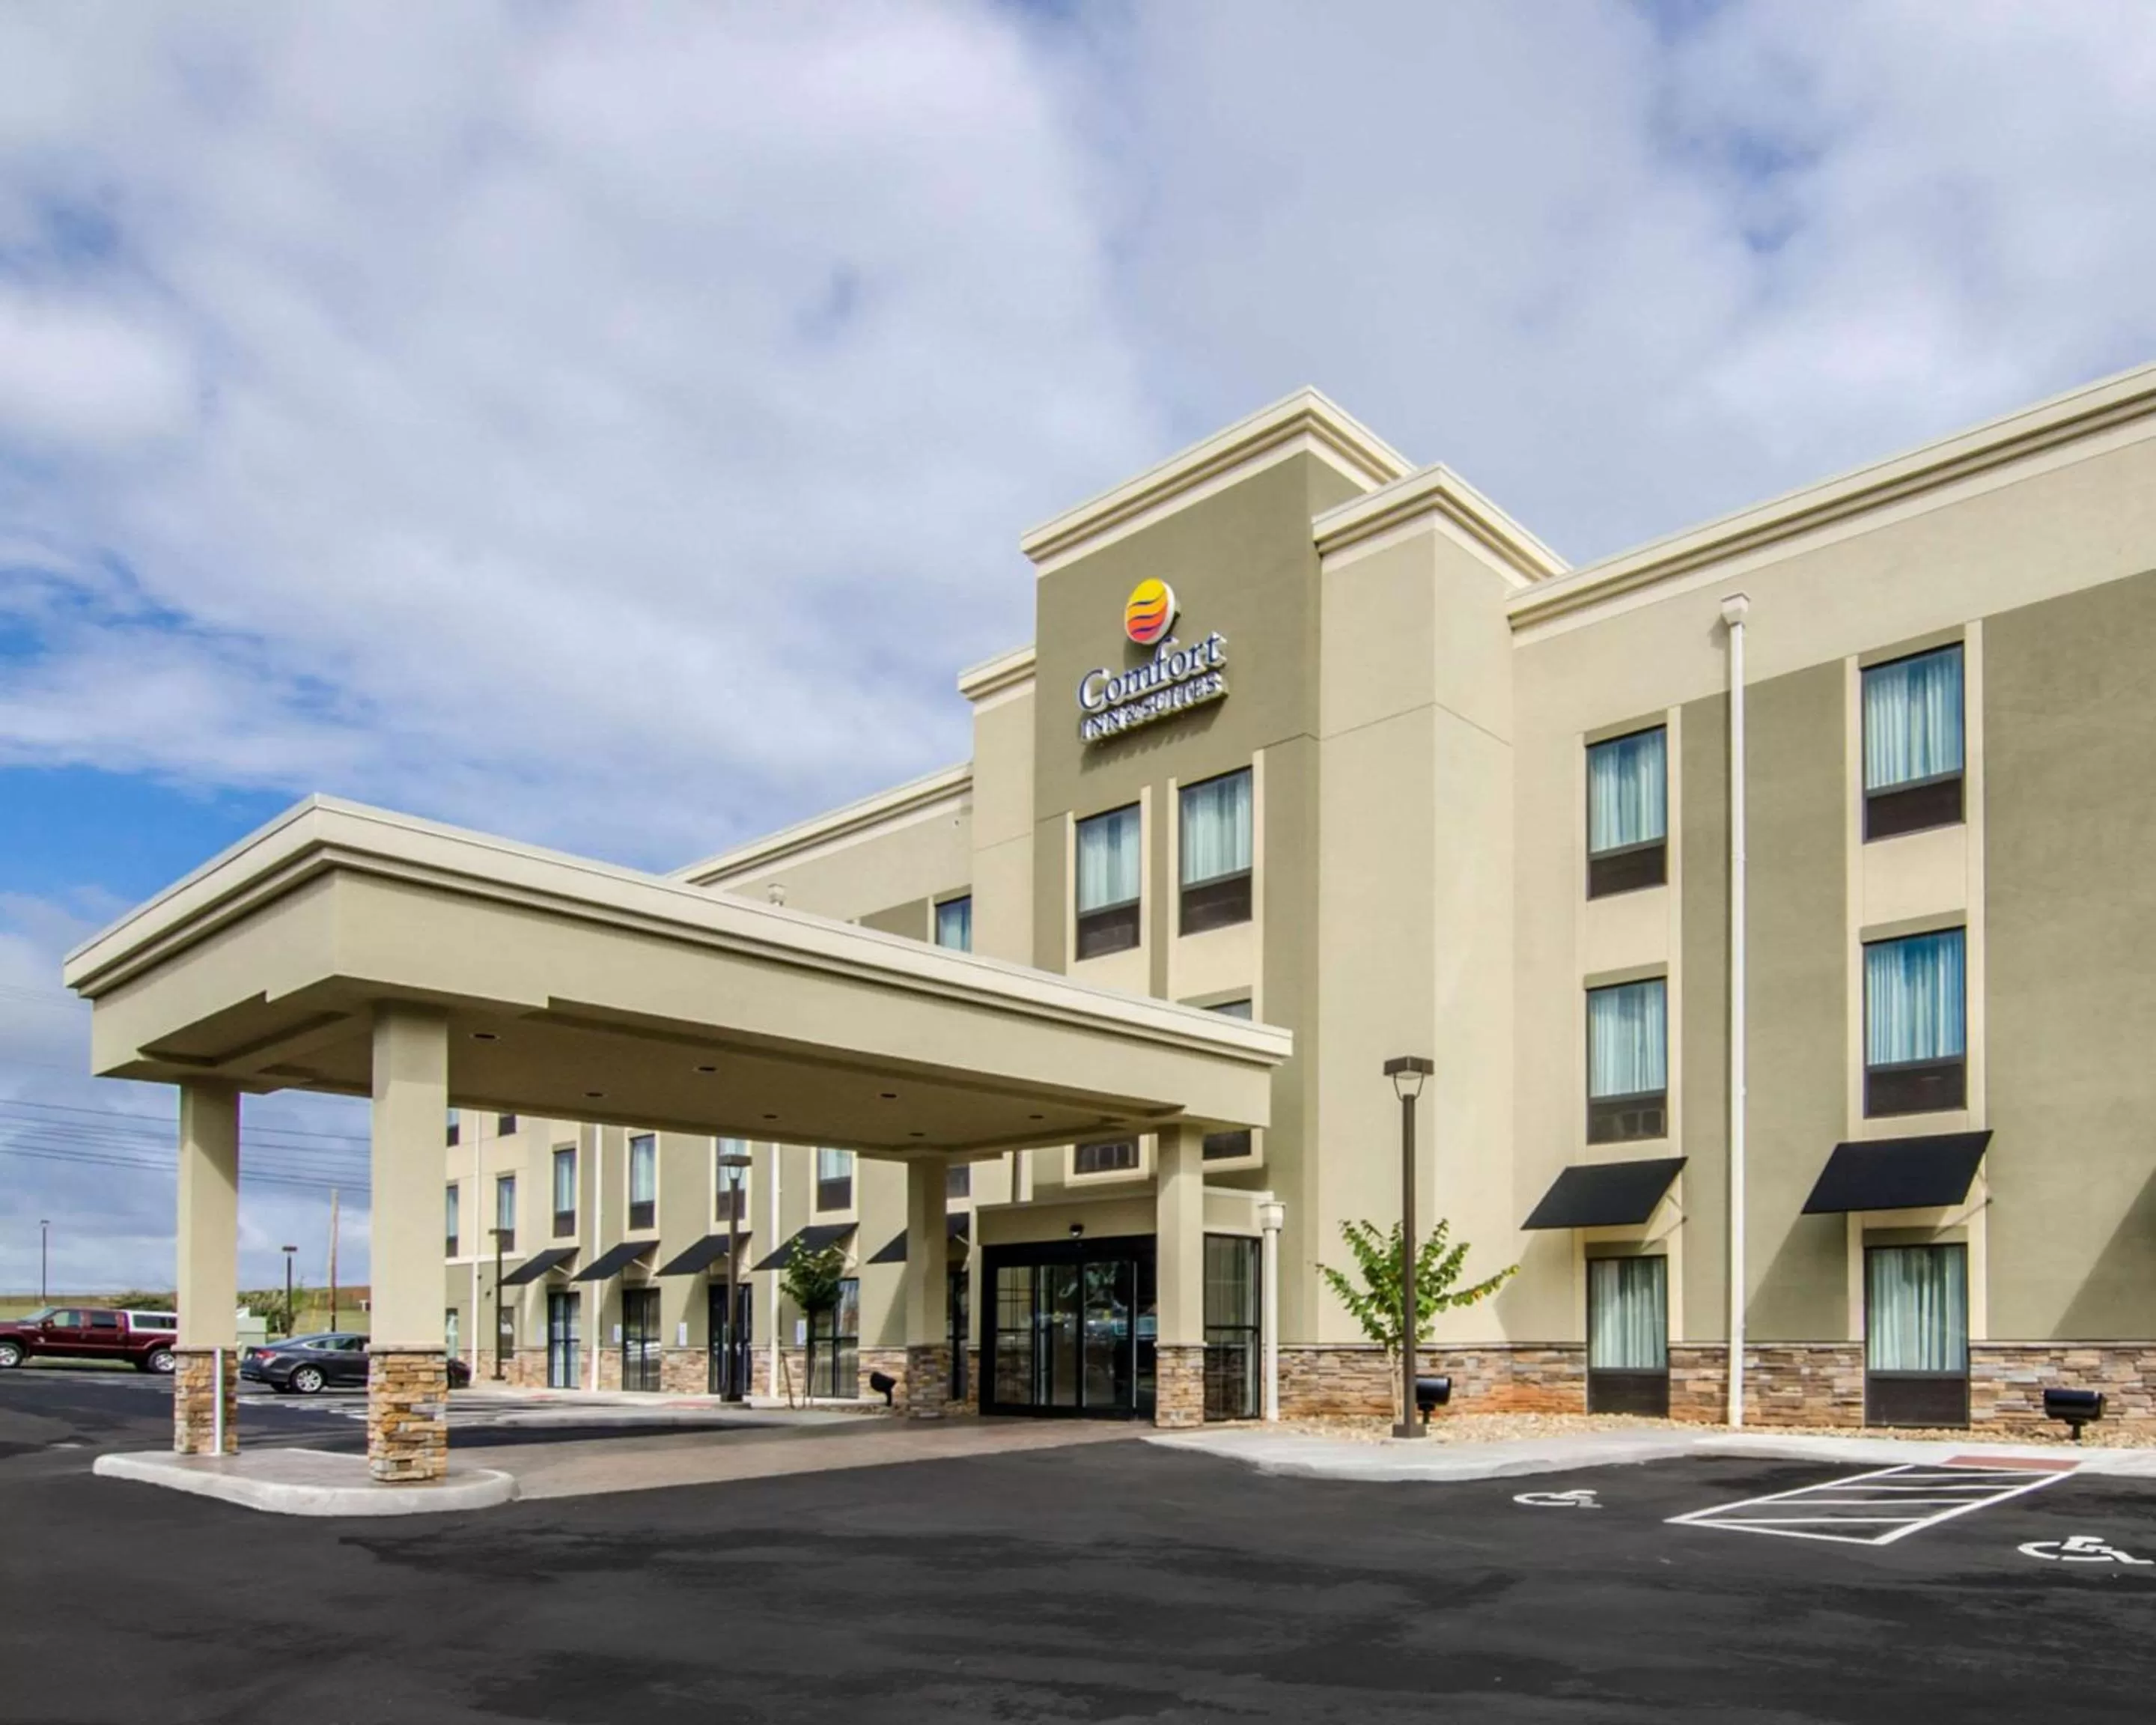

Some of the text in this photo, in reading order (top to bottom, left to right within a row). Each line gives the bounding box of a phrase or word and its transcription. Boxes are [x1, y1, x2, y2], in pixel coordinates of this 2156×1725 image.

[1078, 632, 1227, 711] Comfort
[1081, 673, 1225, 741] INN & SUITES
